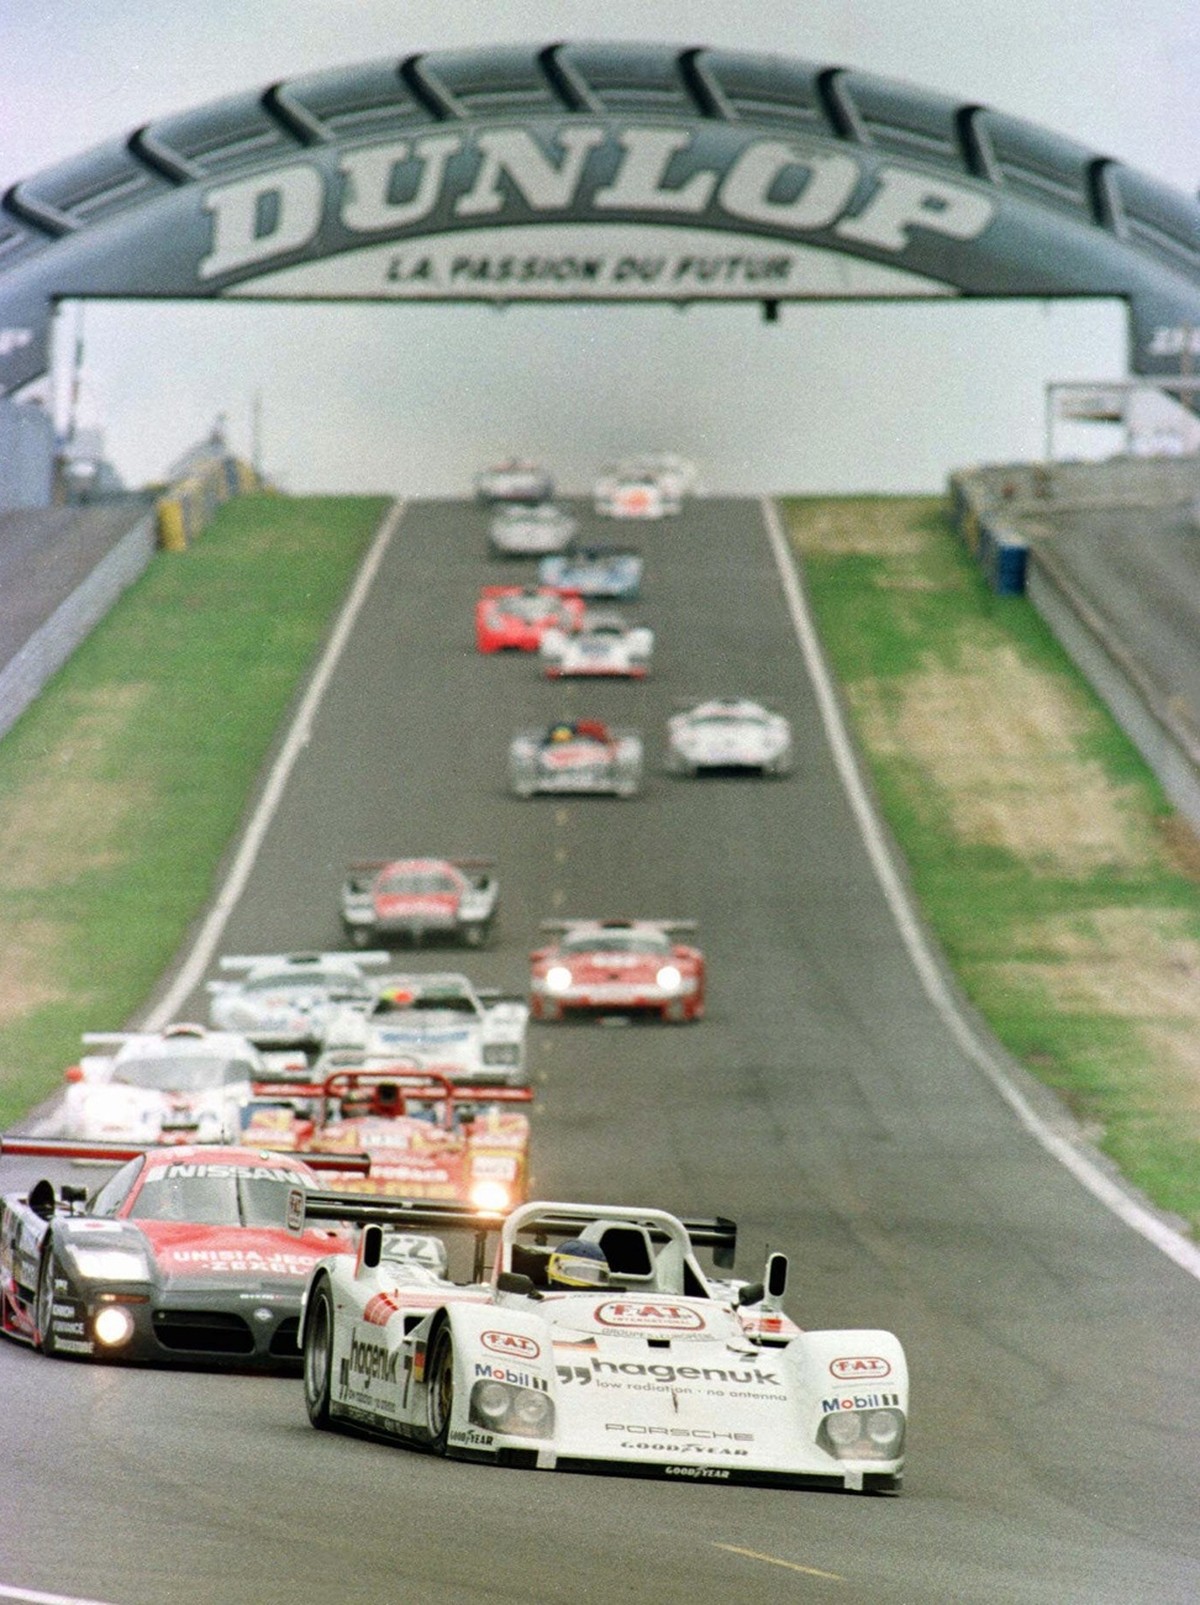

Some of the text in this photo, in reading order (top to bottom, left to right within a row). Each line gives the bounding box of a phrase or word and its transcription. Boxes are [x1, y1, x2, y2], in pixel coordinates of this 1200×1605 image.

[199, 128, 994, 278] DUNLOP
[386, 255, 791, 282] LA PASSION DU FUTUR
[168, 1164, 302, 1185] NISSAN
[173, 1250, 263, 1262] UNISIA
[383, 1237, 433, 1261] 22
[475, 1364, 529, 1387] Mobil
[590, 1357, 782, 1386] hagenuk
[595, 1379, 788, 1401] low radiation no antenna
[822, 1394, 879, 1413] Mobil
[605, 1423, 755, 1441] PORSCHE
[620, 1442, 749, 1456] GOODYEAR
[665, 1465, 730, 1479] GOODYEAR
